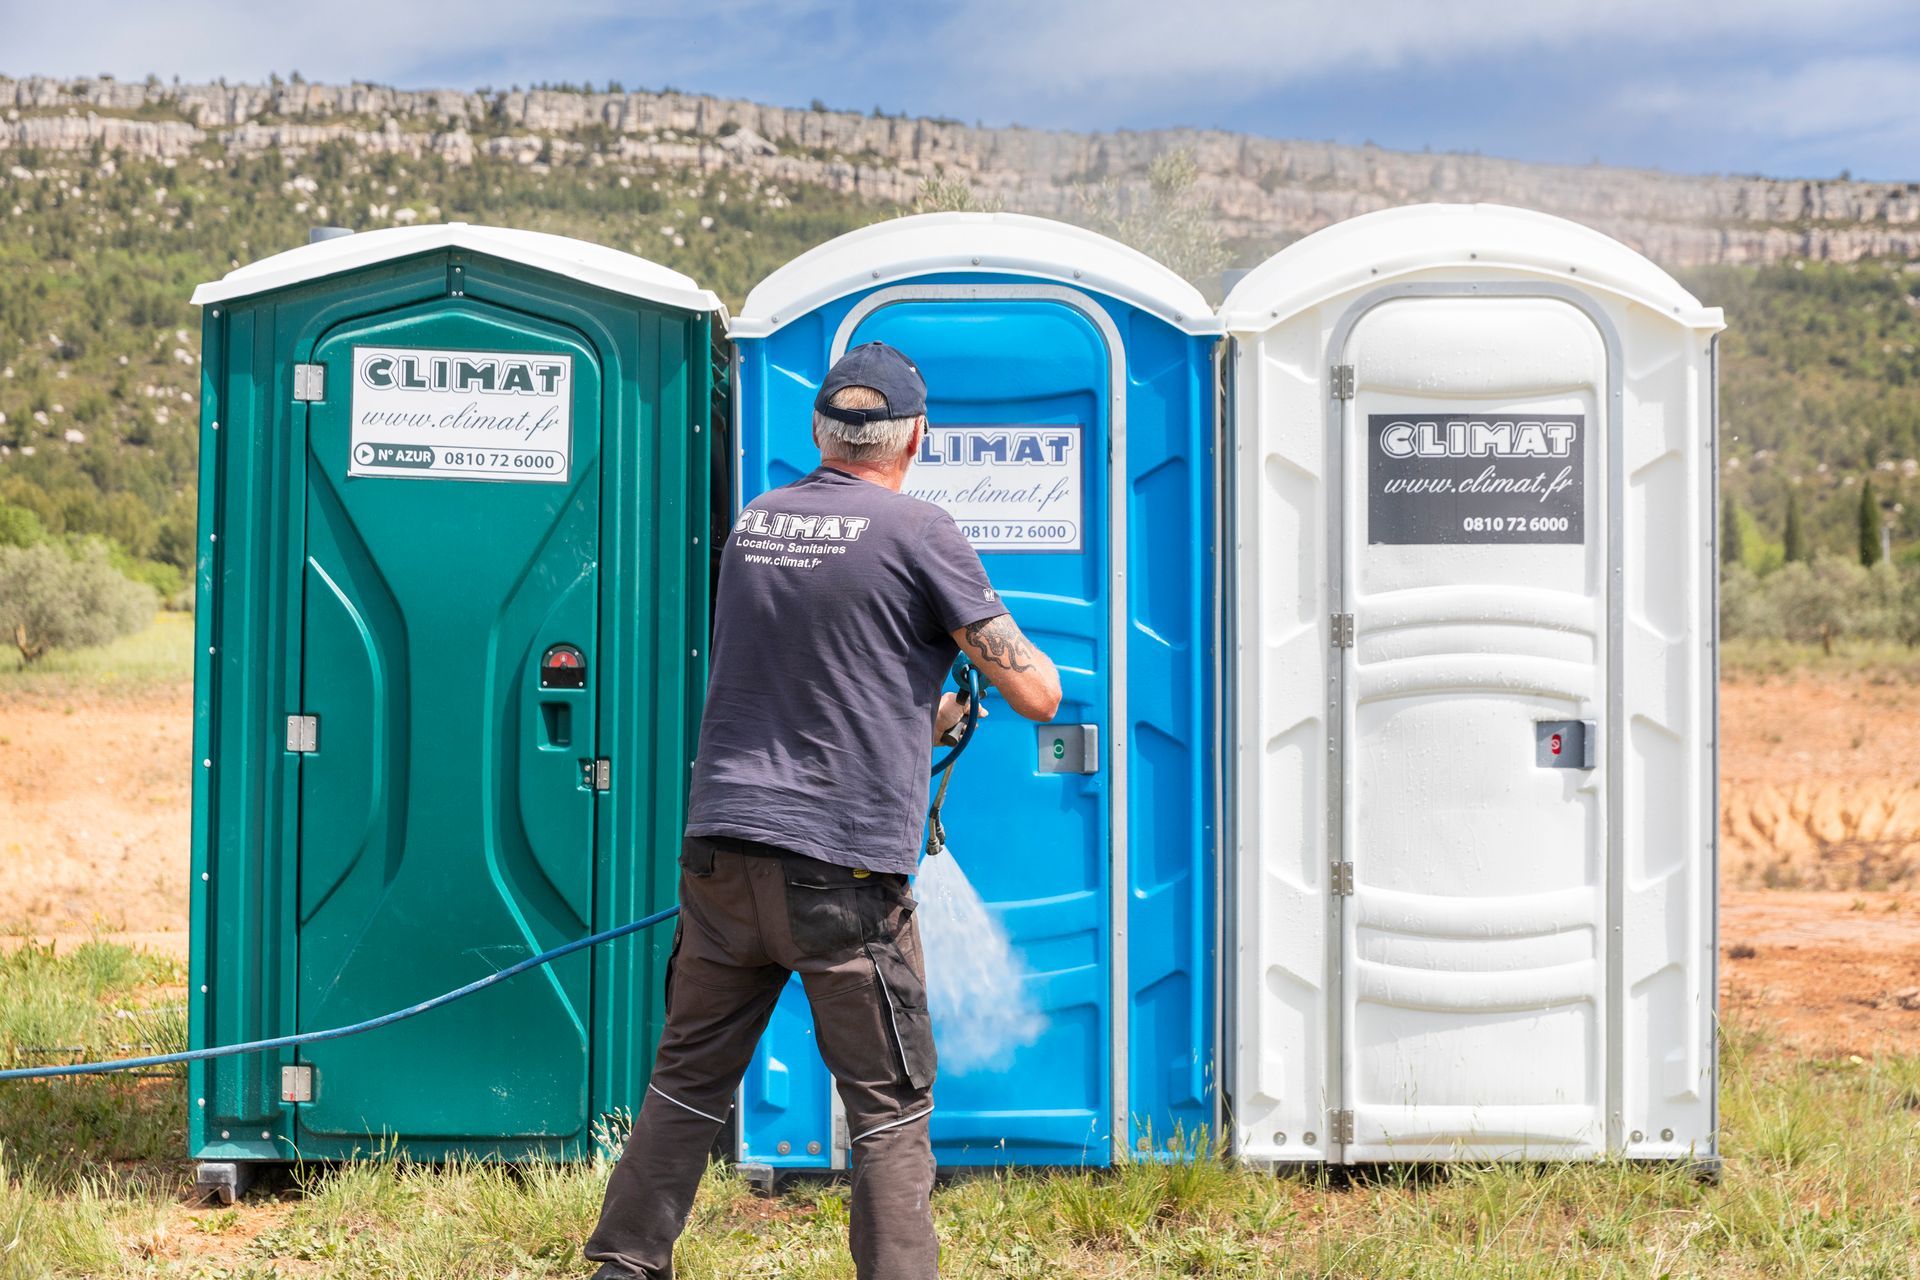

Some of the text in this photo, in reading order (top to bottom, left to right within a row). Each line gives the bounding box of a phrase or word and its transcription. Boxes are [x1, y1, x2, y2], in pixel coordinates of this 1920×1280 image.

[360, 354, 566, 396] CLIMAT
[361, 402, 559, 441] www.climat.fr
[915, 432, 1073, 466] LIMAT
[1380, 422, 1576, 458] CLIMAT
[395, 449, 432, 463] AZUR
[444, 451, 485, 466] 0810
[490, 453, 509, 467] 72
[513, 454, 554, 469] 6000
[1384, 465, 1573, 503] www.climat.fr
[962, 525, 1066, 538] 0810 72 6000
[1463, 517, 1569, 531] 0810 72 6000
[736, 536, 846, 554] Location Sanitaires
[744, 554, 822, 569] www.climat.fr
